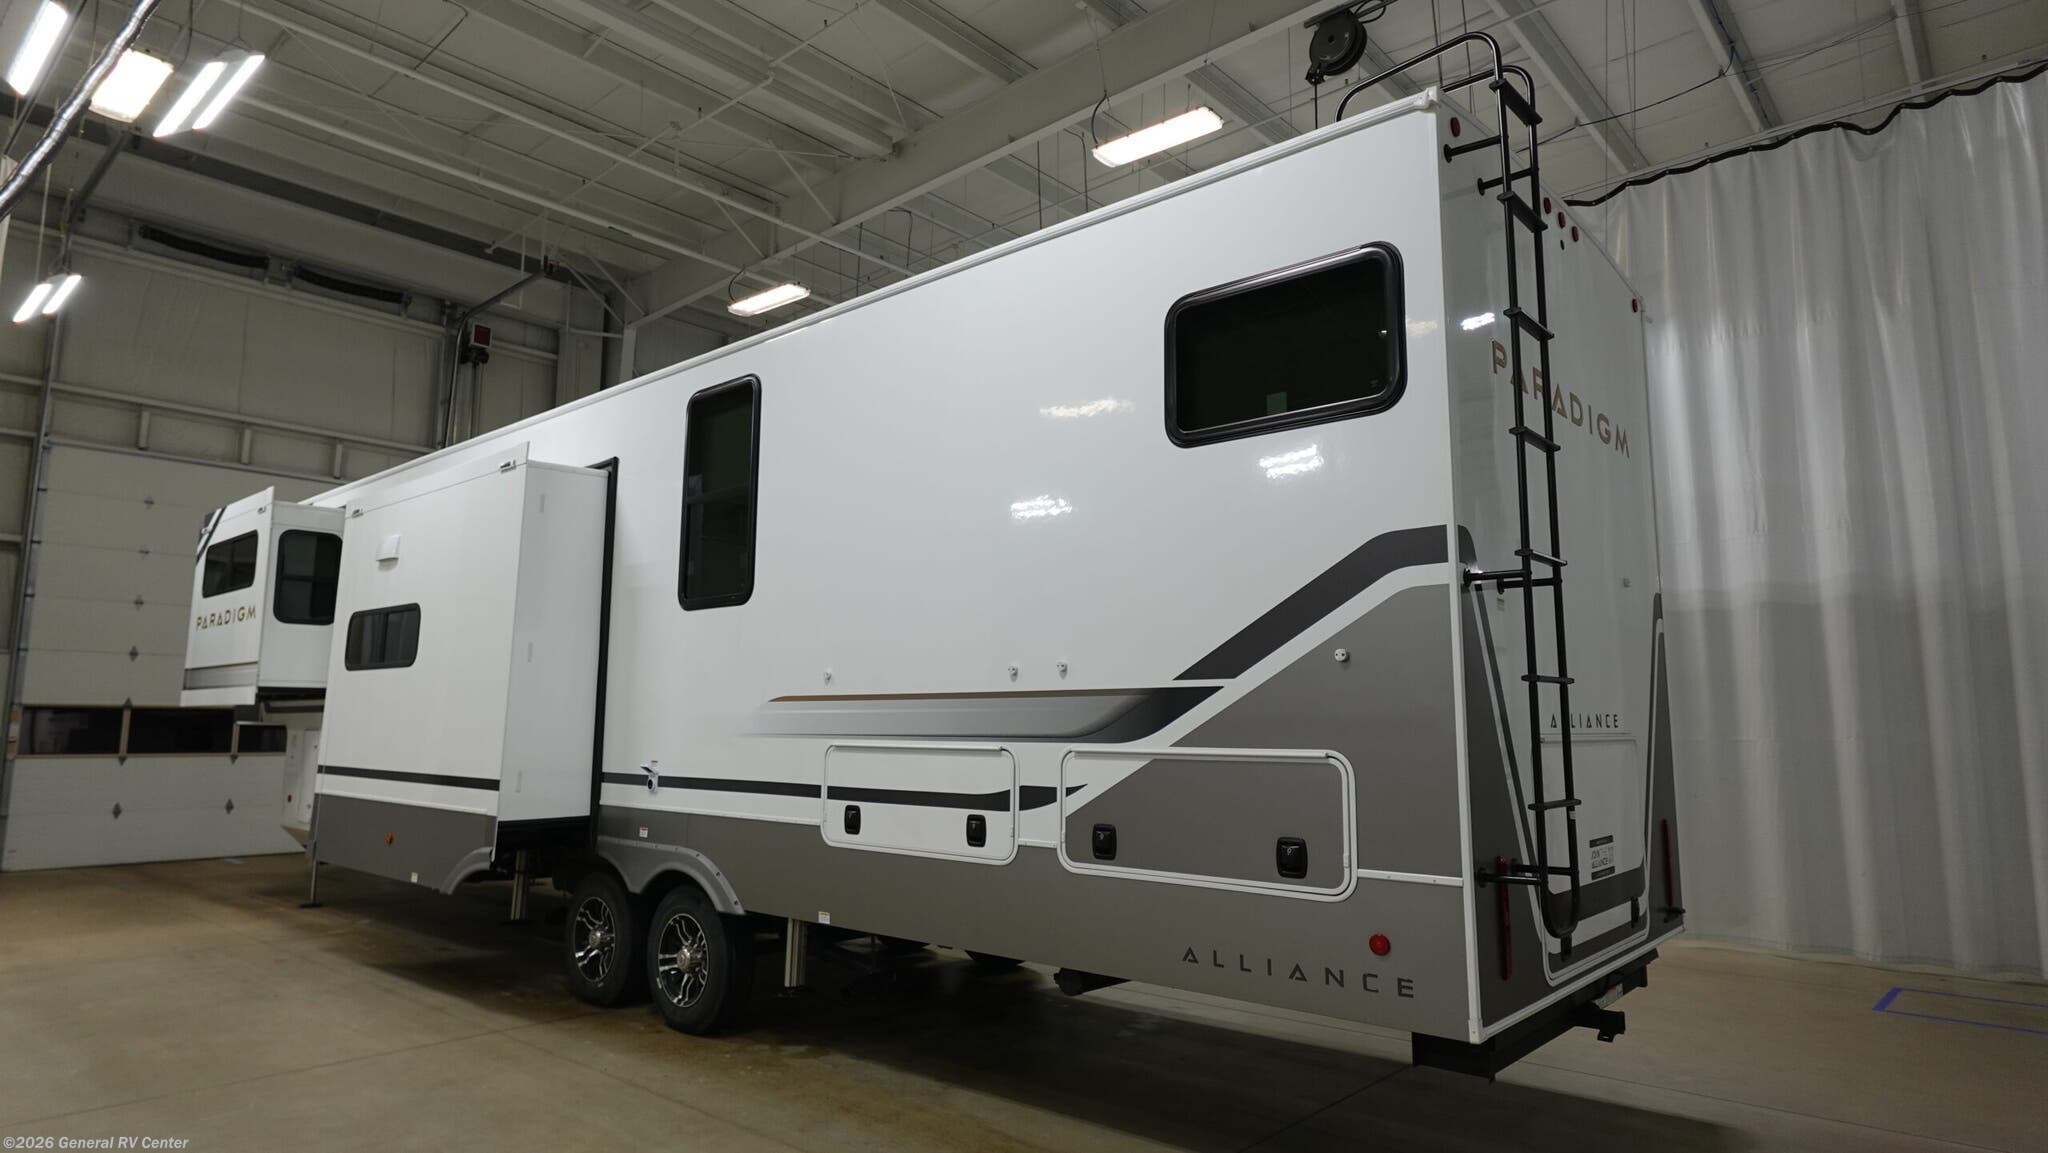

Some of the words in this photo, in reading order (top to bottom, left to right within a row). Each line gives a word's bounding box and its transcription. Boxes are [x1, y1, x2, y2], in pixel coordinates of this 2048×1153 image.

[195, 605, 256, 631] PARADIGM
[1550, 713, 1619, 729] ALIANCE
[1182, 946, 1414, 998] ALLIANCE
